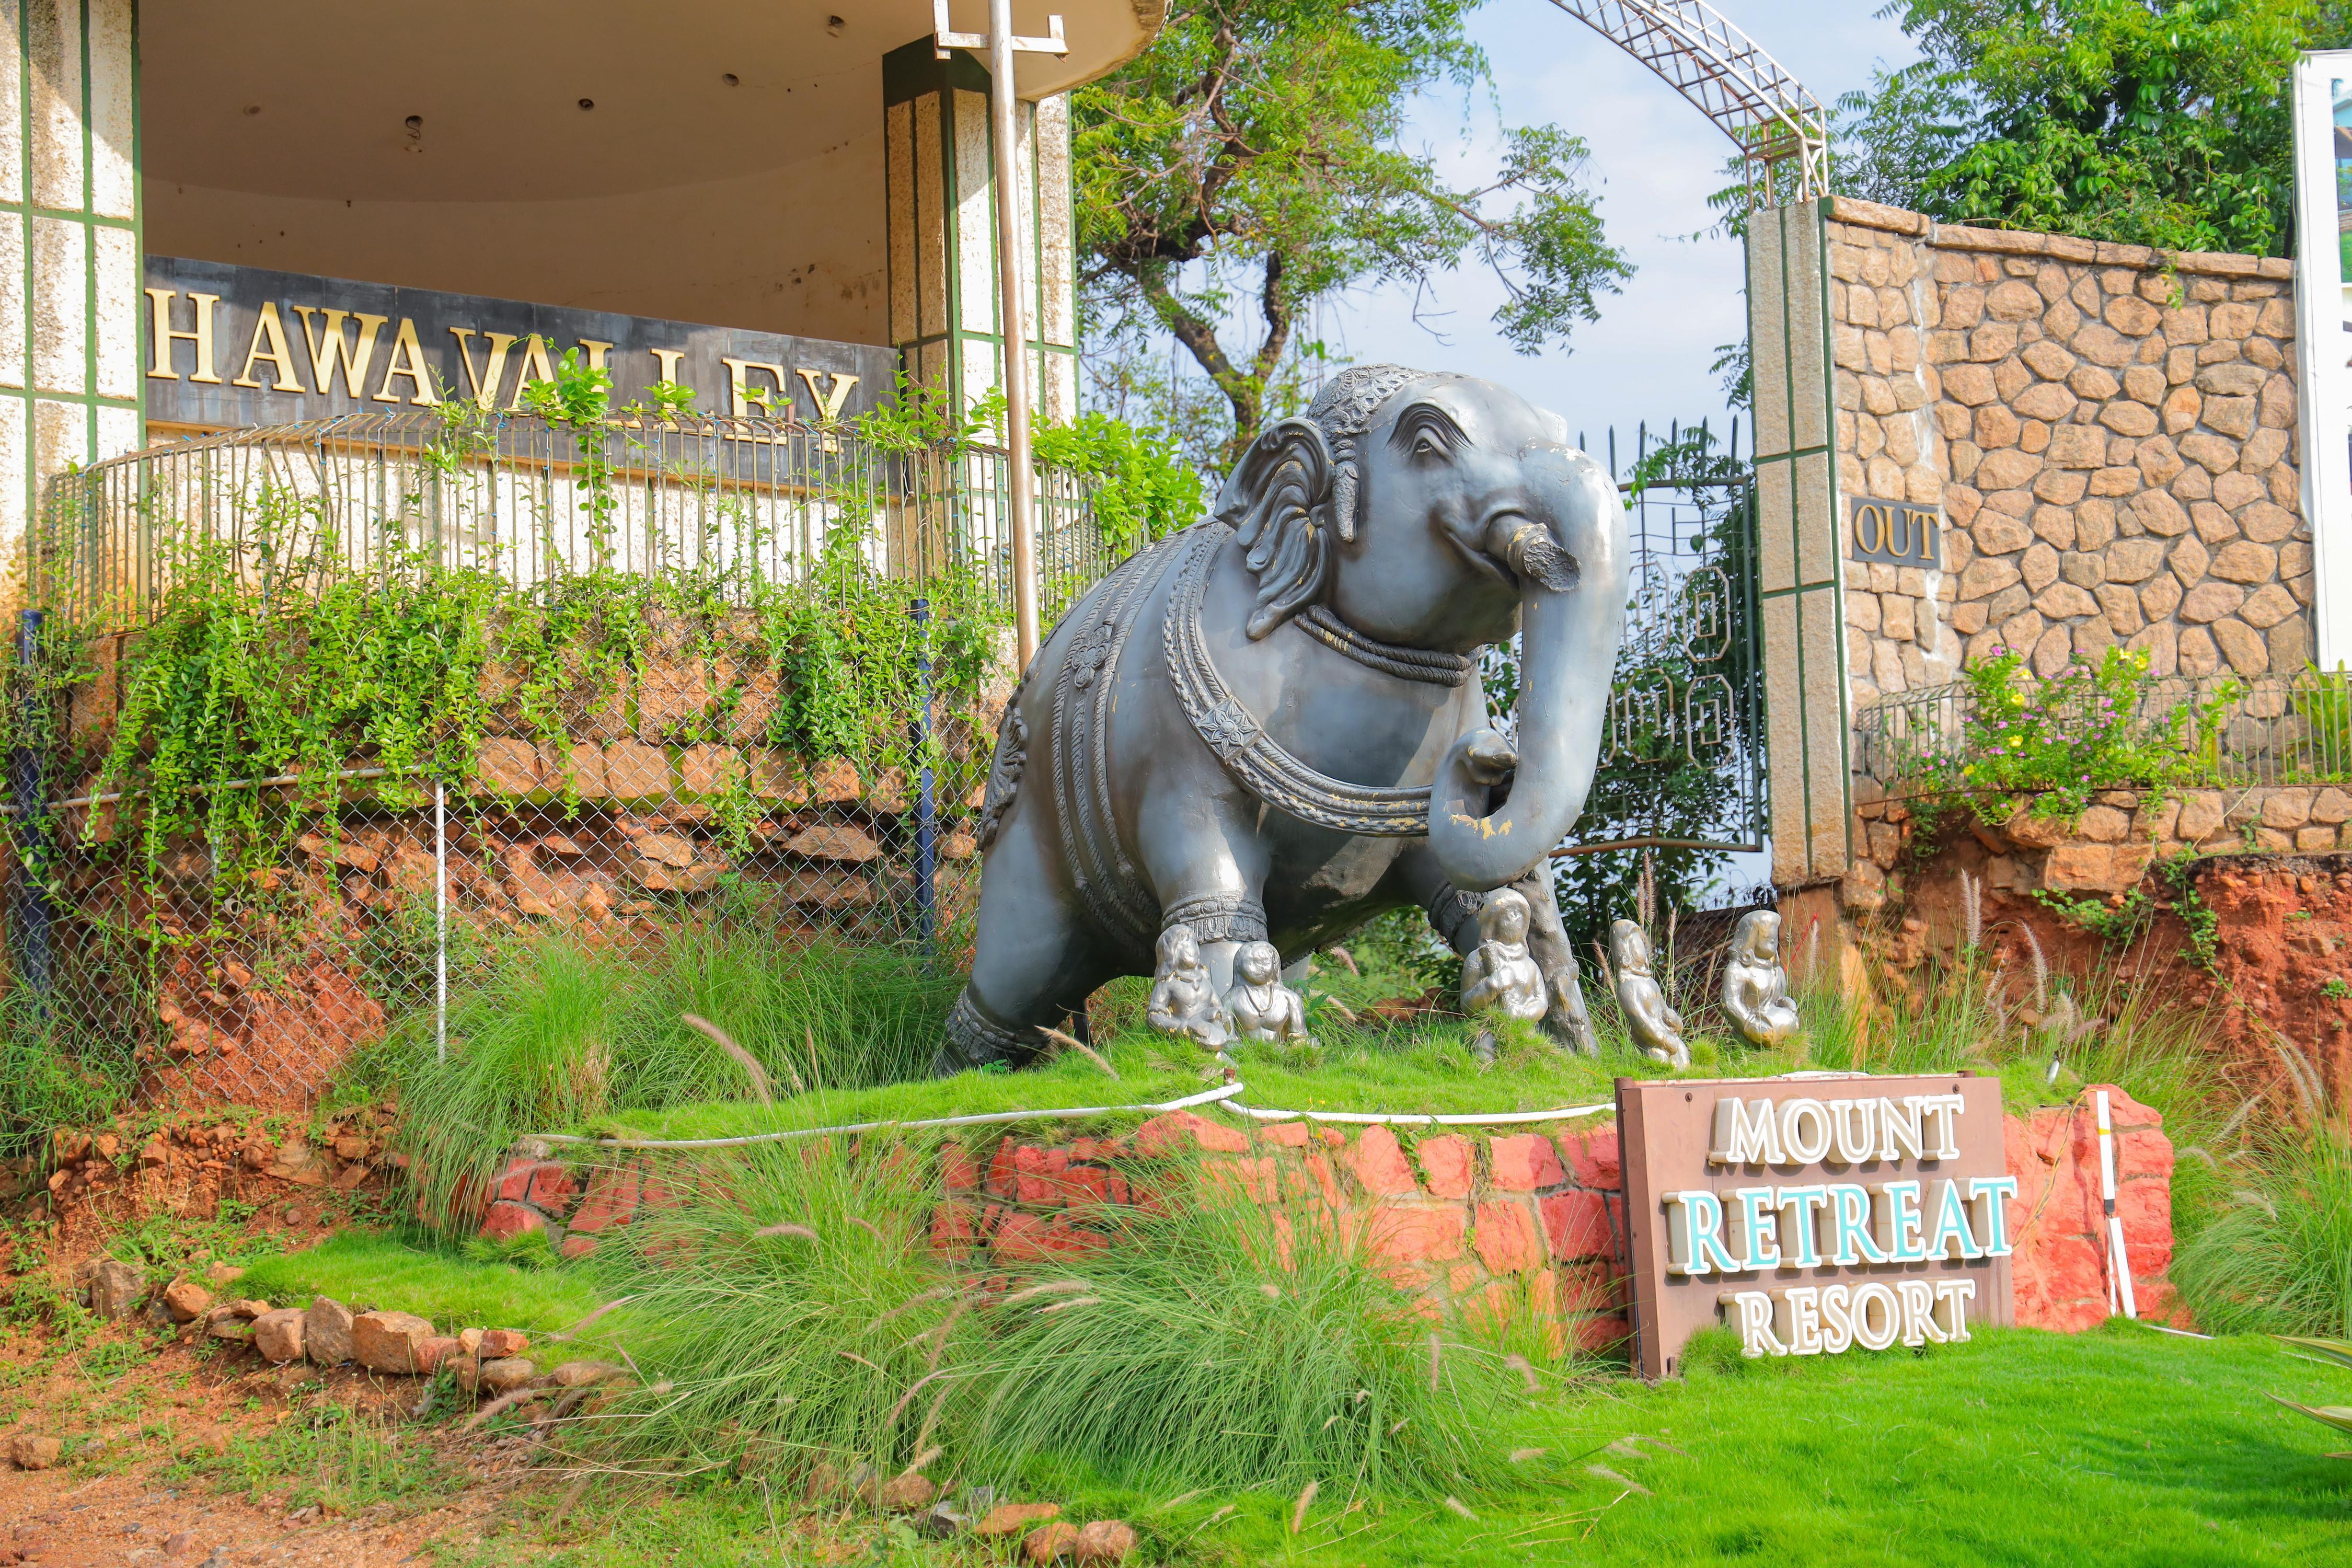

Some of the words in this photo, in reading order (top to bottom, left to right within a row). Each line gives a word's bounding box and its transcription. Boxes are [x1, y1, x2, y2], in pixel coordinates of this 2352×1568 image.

[145, 287, 443, 406] HAWA
[1855, 504, 1940, 560] OUT
[1725, 1093, 1964, 1165] MOUNT
[1678, 1175, 2018, 1275] RETREAT
[1734, 1278, 1976, 1358] RESORT
